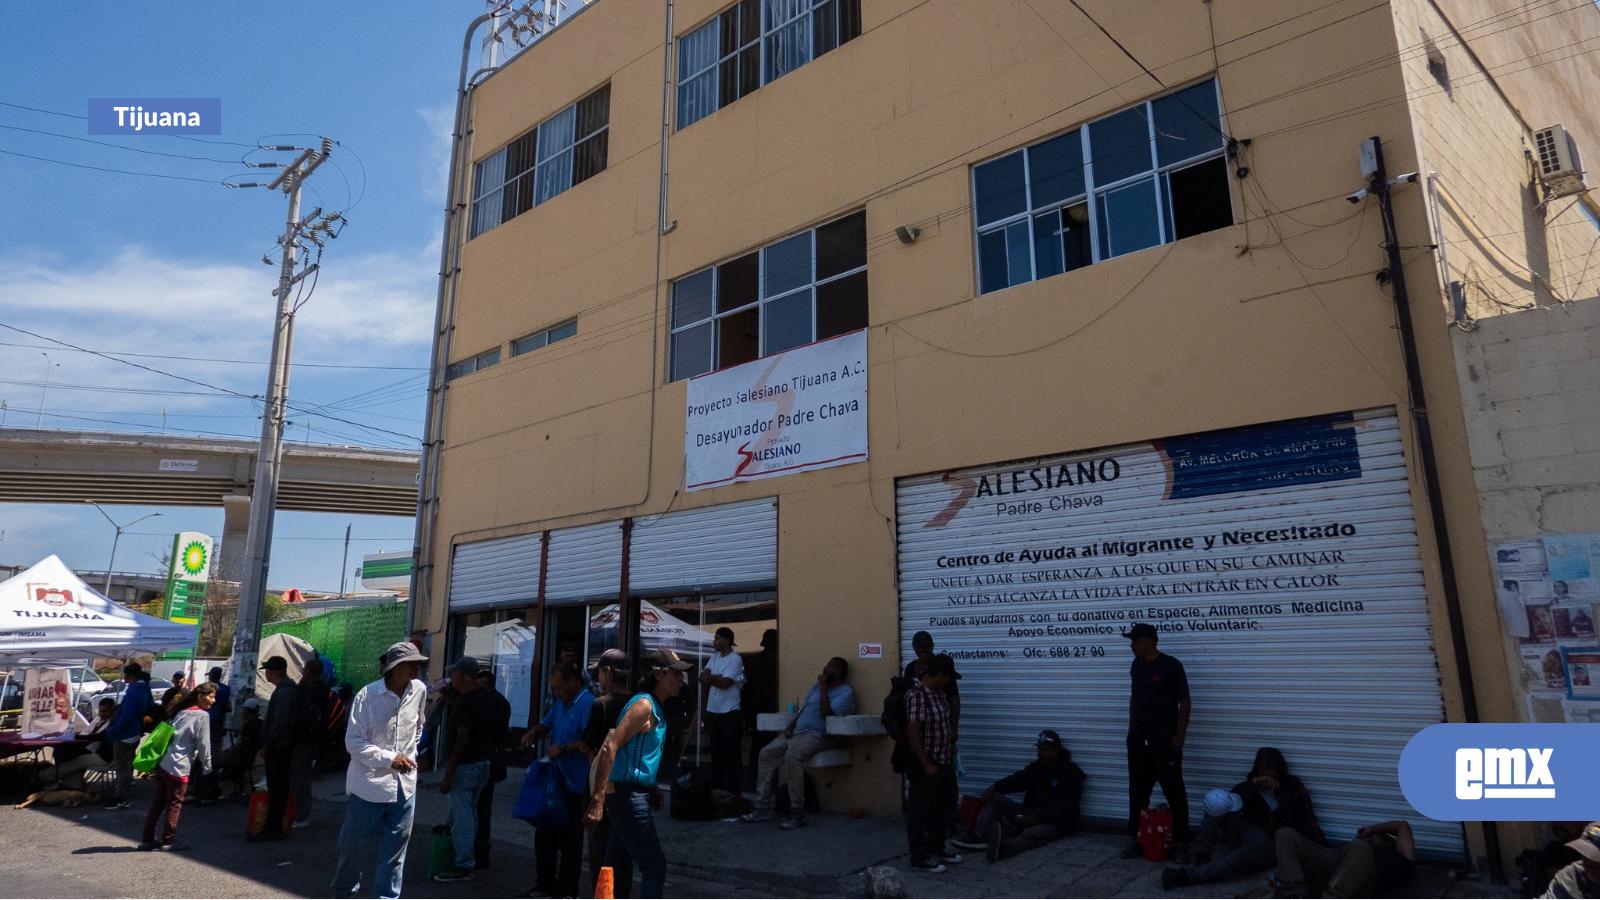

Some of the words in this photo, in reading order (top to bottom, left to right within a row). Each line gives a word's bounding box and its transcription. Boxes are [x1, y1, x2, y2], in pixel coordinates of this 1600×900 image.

[688, 397, 732, 417] Proyecto
[736, 382, 788, 403] Salesiano
[792, 371, 836, 391] Tijuana
[842, 361, 865, 378] A.C.
[696, 419, 773, 447] Desayunador
[778, 409, 815, 426] Padre
[819, 399, 859, 419] Chava
[997, 501, 1042, 517] Padre
[1049, 493, 1103, 511] Chava
[937, 553, 990, 568] Centro
[994, 551, 1014, 563] de
[1019, 546, 1076, 564] Ayuda
[1082, 543, 1098, 557] al
[1103, 536, 1194, 557] Migrante
[1204, 536, 1216, 551] y
[1222, 523, 1357, 545] Necesitado
[975, 575, 983, 586] A
[986, 573, 1014, 585] DAR
[1022, 567, 1103, 583] ESPERANZA
[1110, 567, 1122, 578] A
[1124, 563, 1154, 577] LOS
[1157, 560, 1190, 575] QUE
[1196, 558, 1218, 572] EN
[1222, 556, 1244, 570] SU
[1252, 550, 1345, 569] CAMINAR
[948, 595, 966, 606] NO
[969, 594, 990, 605] LES
[993, 590, 1058, 604] ALCANZA
[1062, 588, 1081, 600] LA
[1084, 586, 1121, 599] VIDA
[1126, 584, 1168, 597] PARA
[1173, 580, 1241, 595] ENTRAR
[1246, 577, 1268, 590] EN
[1273, 574, 1341, 589] CALOR
[12, 610, 105, 621] TIJUANA
[930, 616, 966, 626] Puedes
[969, 614, 1024, 628] ayudarnos
[1030, 613, 1051, 623] con
[1057, 612, 1069, 622] tu
[1072, 609, 1125, 622] donativo
[1128, 610, 1144, 620] en
[1209, 601, 1283, 617] Alimentos
[1291, 599, 1365, 614] Medicina
[1008, 626, 1043, 637] Apoyo
[1047, 624, 1114, 636] Economico
[1118, 625, 1127, 635] y
[1023, 647, 1047, 658] Ofc:
[1049, 646, 1071, 658] 688
[1073, 647, 1087, 658] 27
[1091, 646, 1105, 658] 90
